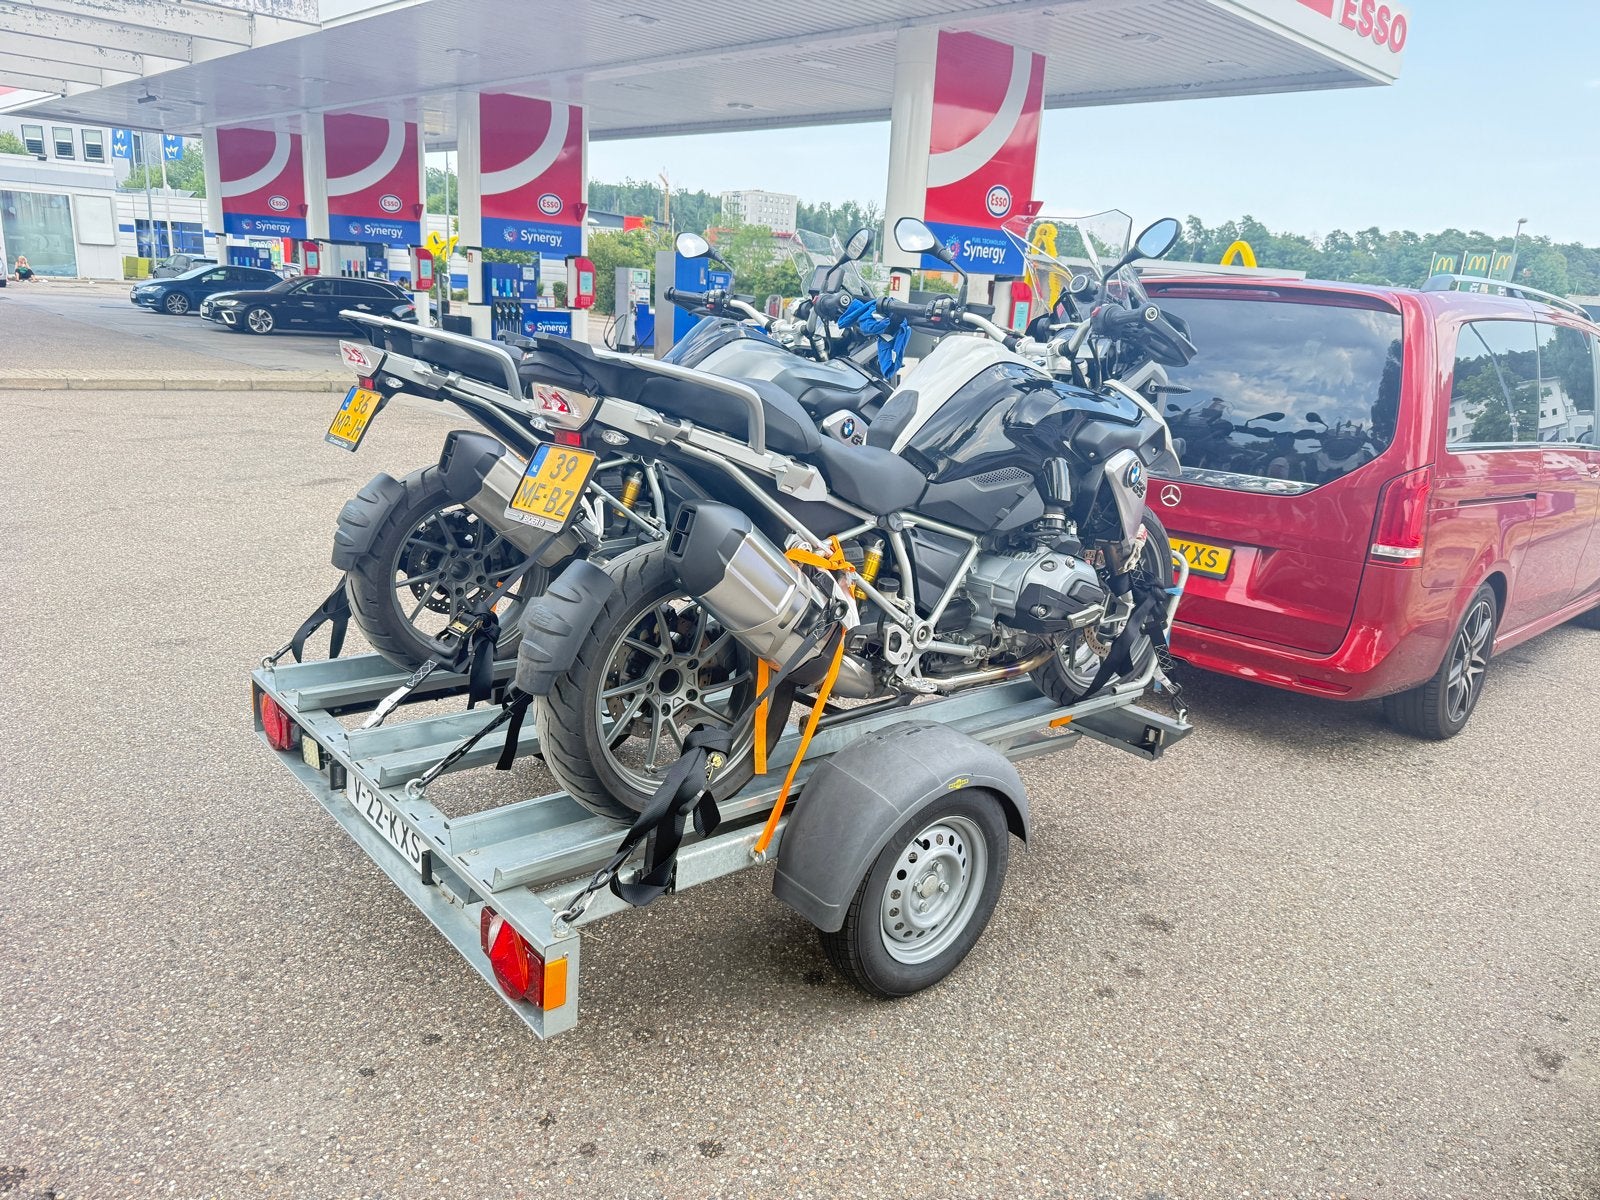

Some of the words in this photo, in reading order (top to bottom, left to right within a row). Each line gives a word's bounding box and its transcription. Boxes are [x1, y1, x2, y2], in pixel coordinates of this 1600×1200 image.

[1339, 0, 1407, 53] ESSO
[542, 199, 559, 209] Esso
[990, 193, 1008, 208] Esso
[255, 220, 290, 233] Synergy
[364, 224, 402, 238] Synergy
[520, 229, 562, 247] Synergy
[963, 240, 1006, 264] Synergy
[537, 322, 568, 334] Synergy
[353, 393, 372, 415] 36
[549, 453, 579, 482] 39
[515, 480, 576, 517] MF-BZ
